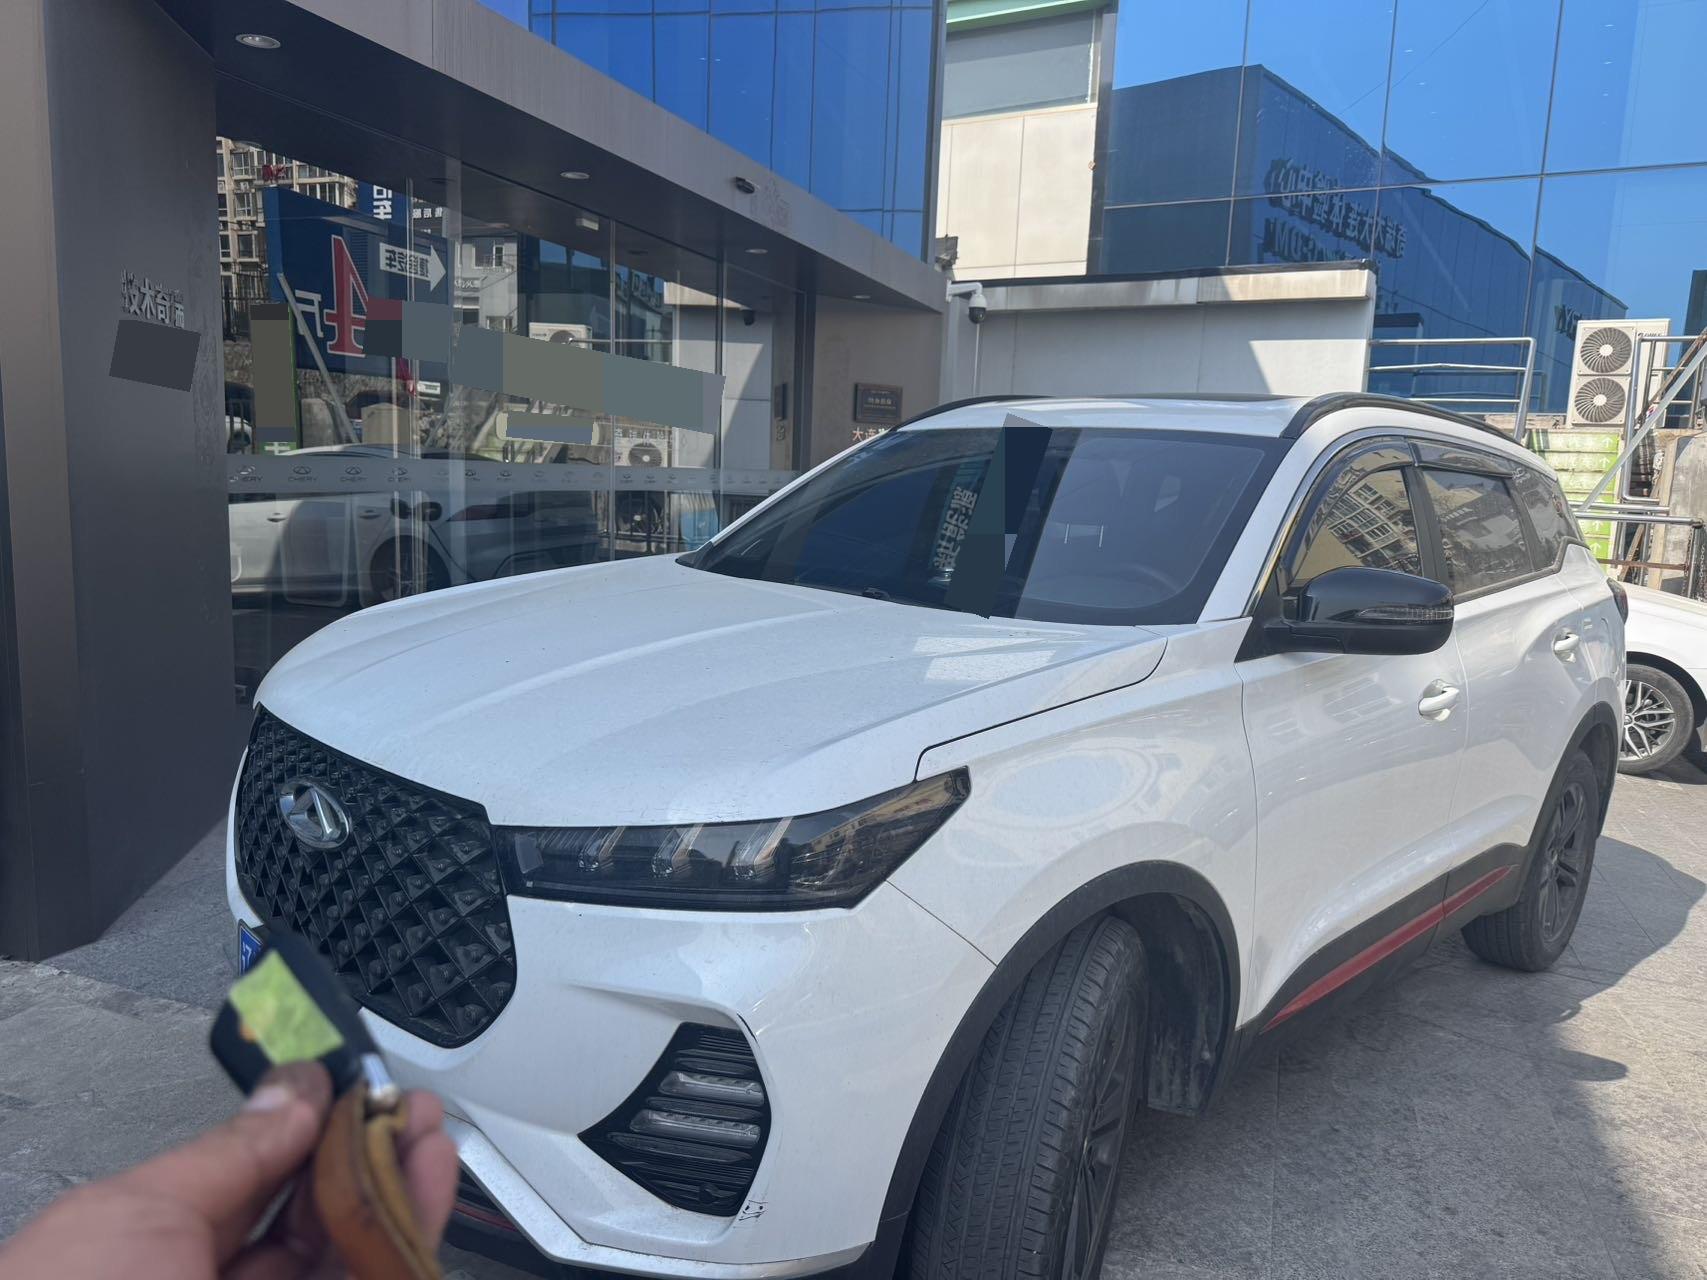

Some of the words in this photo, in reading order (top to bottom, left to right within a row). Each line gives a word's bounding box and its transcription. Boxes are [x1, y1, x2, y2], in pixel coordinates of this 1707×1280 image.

[120, 269, 184, 329] 技术奇瑞
[852, 427, 885, 441] 大连
